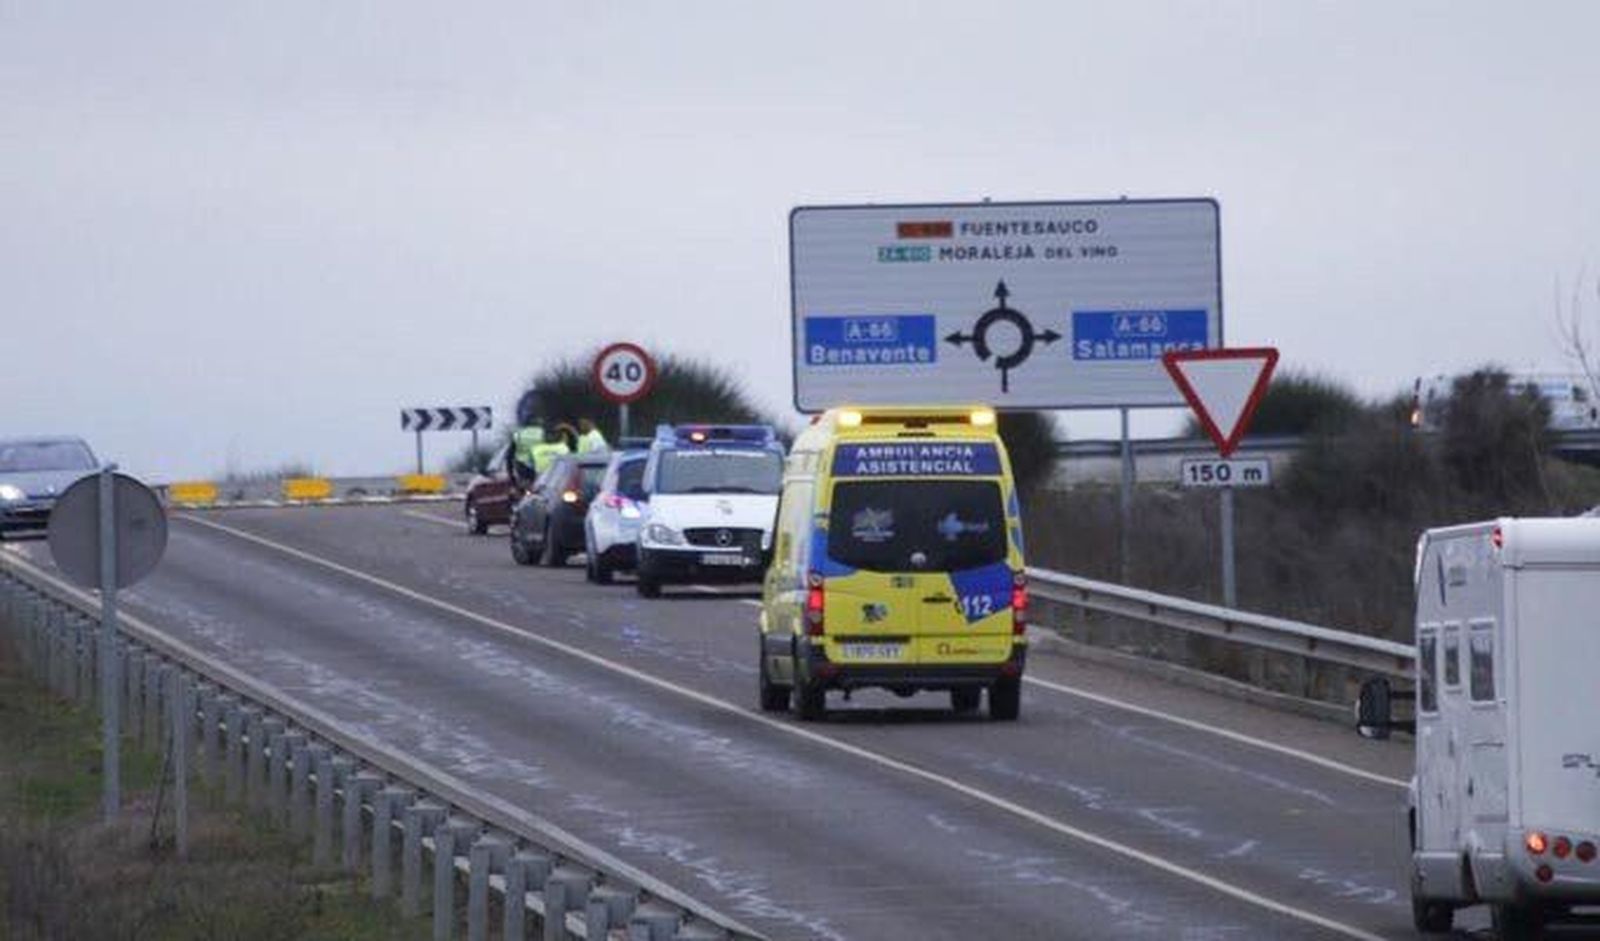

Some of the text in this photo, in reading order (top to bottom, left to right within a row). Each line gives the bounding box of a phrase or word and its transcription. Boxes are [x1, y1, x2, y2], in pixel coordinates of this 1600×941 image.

[960, 220, 1098, 236] FUENTESAUCO
[939, 245, 1035, 261] MORALEJA
[1045, 247, 1073, 259] DEL
[1081, 246, 1118, 259] VINO
[810, 344, 930, 363] Benavente
[605, 361, 642, 382] 40
[856, 446, 974, 459] AMBULANCIA
[856, 460, 974, 474] ASISTENCIAL
[1190, 463, 1263, 482] 150 m
[962, 594, 993, 615] 112
